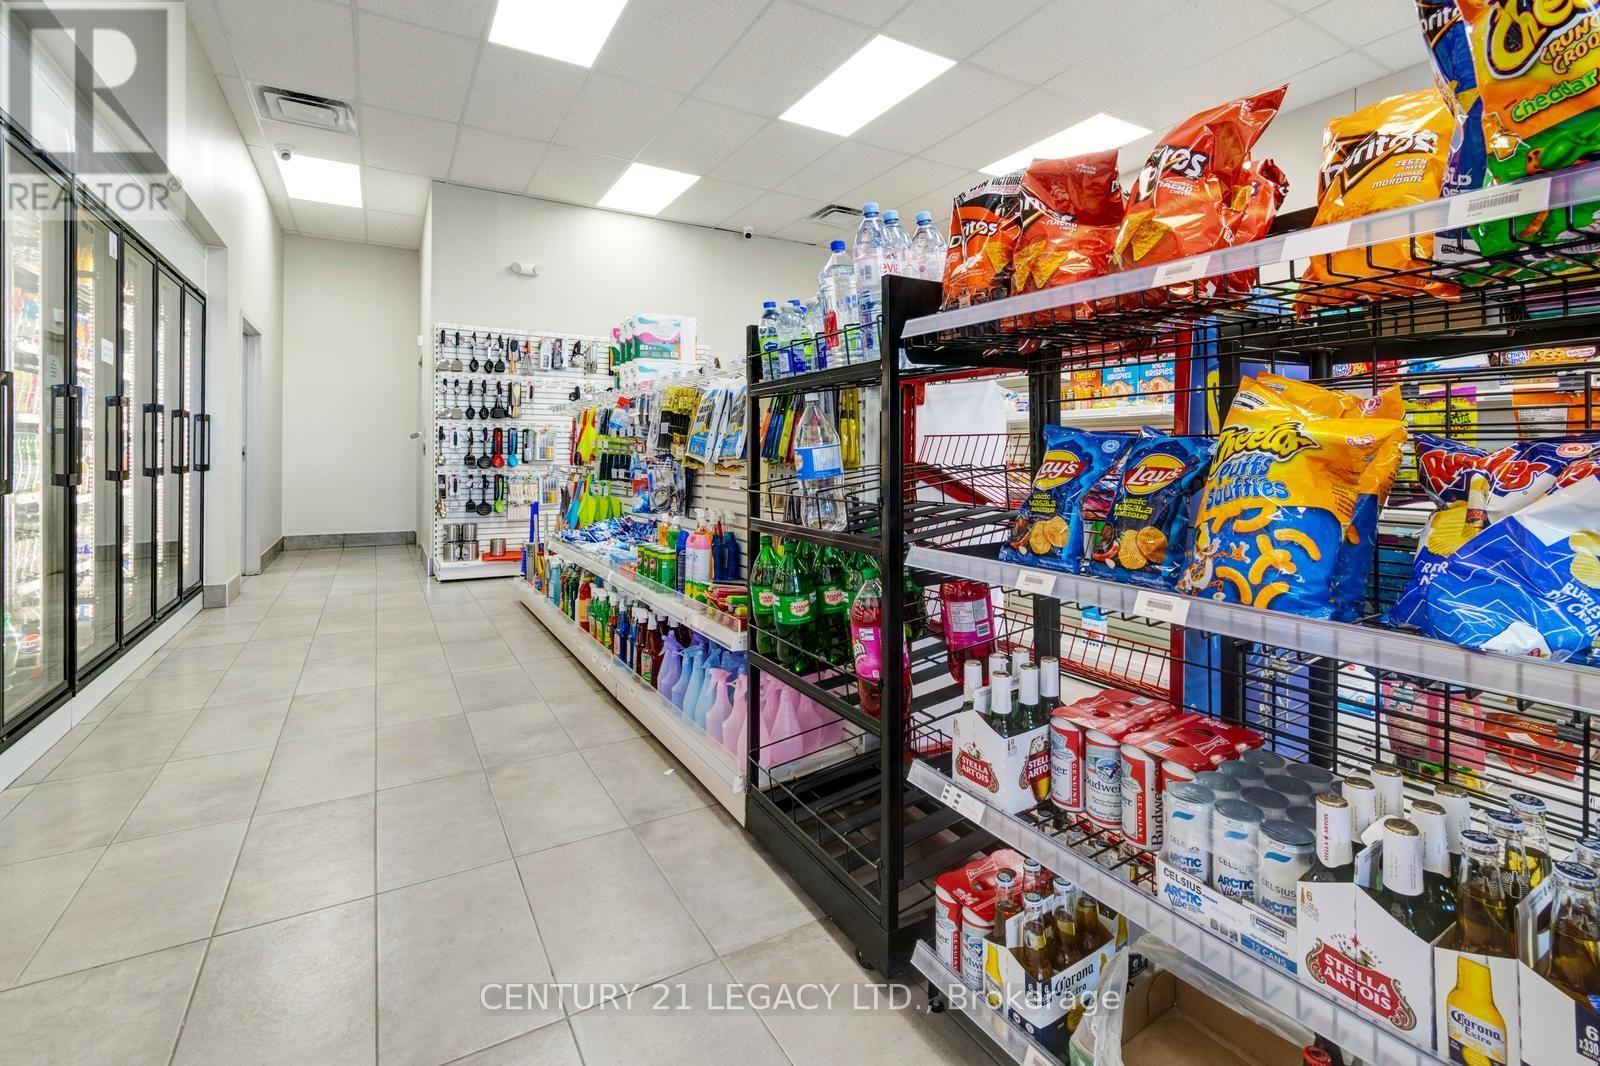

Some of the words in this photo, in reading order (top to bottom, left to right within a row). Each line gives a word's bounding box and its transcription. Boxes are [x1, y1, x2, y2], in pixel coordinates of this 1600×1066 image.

[1395, 158, 1428, 168] ZESTY
[1127, 465, 1182, 487] Lay's
[961, 755, 989, 776] STELLA
[961, 764, 989, 784] ARTOIS
[1163, 867, 1202, 895] CELSIUS
[1217, 873, 1254, 890] ARCTIC
[1164, 882, 1202, 906] ARCTIC
[1251, 942, 1261, 952] 12
[1262, 949, 1287, 967] CANS
[1055, 962, 1094, 996] Corona
[1324, 953, 1391, 999] STELLA
[1323, 965, 1392, 1011] ARTOIS
[1450, 1009, 1502, 1041] Corona
[1464, 1025, 1492, 1047] Extra
[1585, 1024, 1600, 1042] 6
